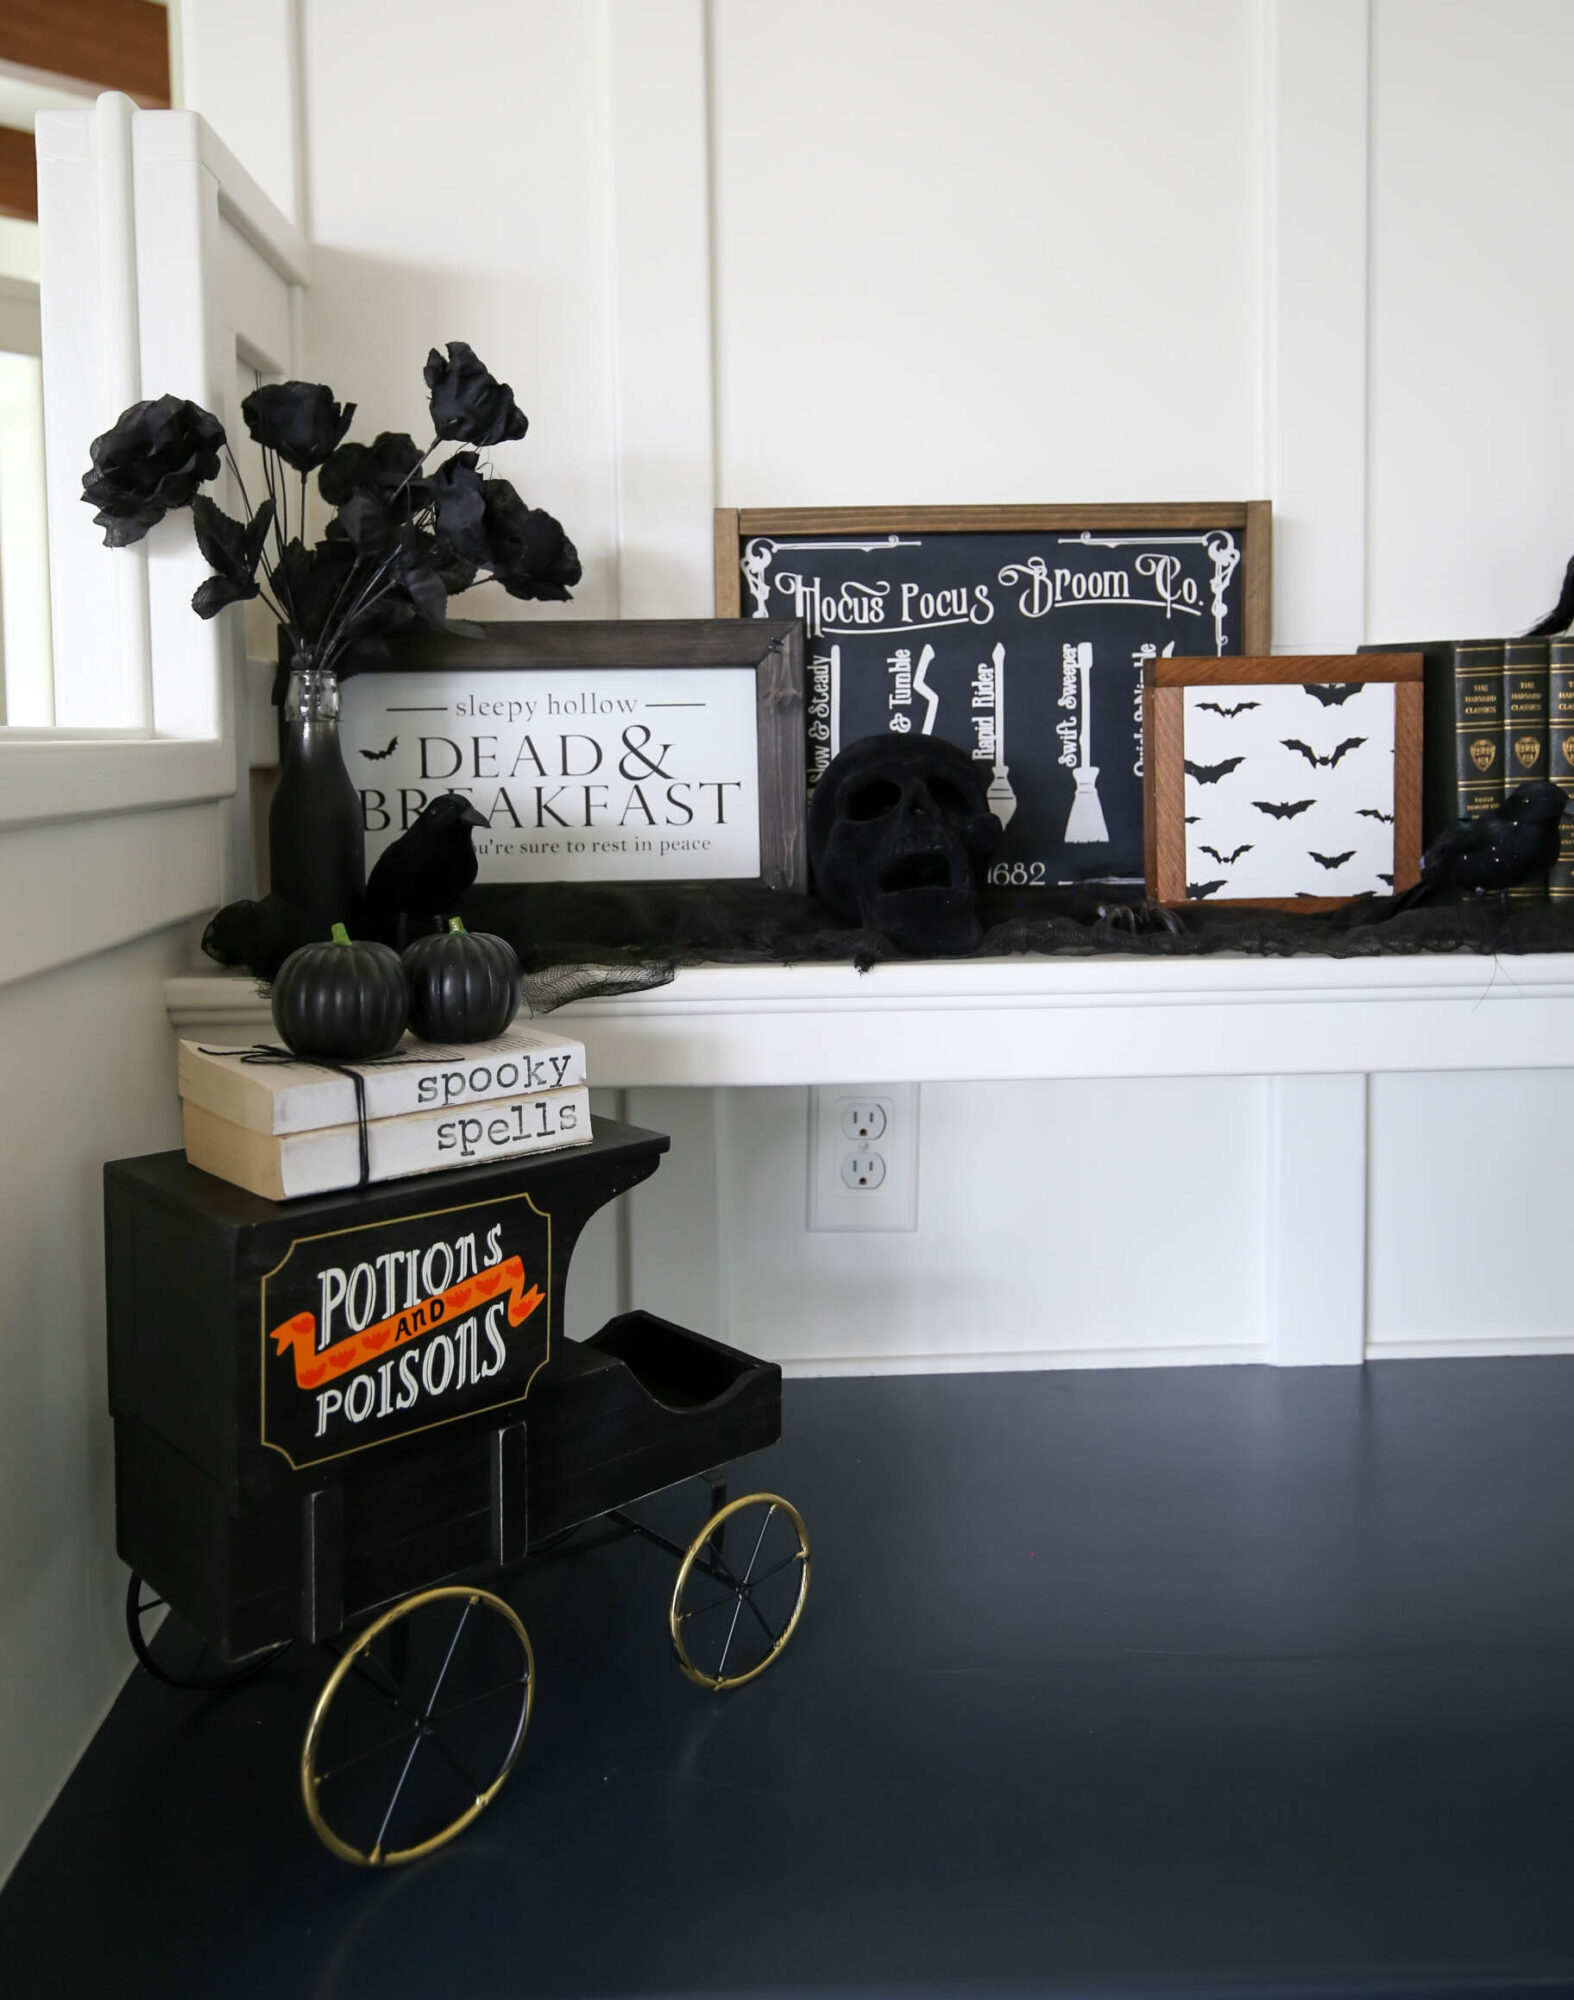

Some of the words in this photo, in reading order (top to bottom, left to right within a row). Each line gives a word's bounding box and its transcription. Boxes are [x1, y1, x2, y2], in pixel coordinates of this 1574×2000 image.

[774, 572, 890, 639] Hocus
[901, 583, 995, 625] Pocus
[998, 556, 1130, 618] Broom
[1135, 553, 1204, 620] Co.
[807, 654, 831, 718] Steady
[887, 648, 912, 710] Tumble
[971, 662, 995, 708] Rider
[1057, 643, 1079, 710] Sweeper
[455, 694, 537, 723] sleepy
[547, 693, 638, 716] hollow
[808, 720, 831, 741] &
[889, 712, 912, 734] &
[418, 734, 603, 780] DEAD
[618, 724, 678, 782] &
[971, 716, 996, 760] Rapid
[1056, 716, 1078, 768] Swift
[358, 781, 742, 832] BRAKFAST
[519, 840, 560, 855] sure
[567, 839, 586, 853] to
[592, 838, 628, 853] rest
[634, 837, 653, 851] in
[660, 837, 712, 856] peace
[987, 861, 1046, 886] 1682
[417, 1052, 572, 1107] spooky
[437, 1101, 578, 1157] spells
[316, 1223, 503, 1351] POTIONS
[314, 1301, 507, 1438] POISONS
